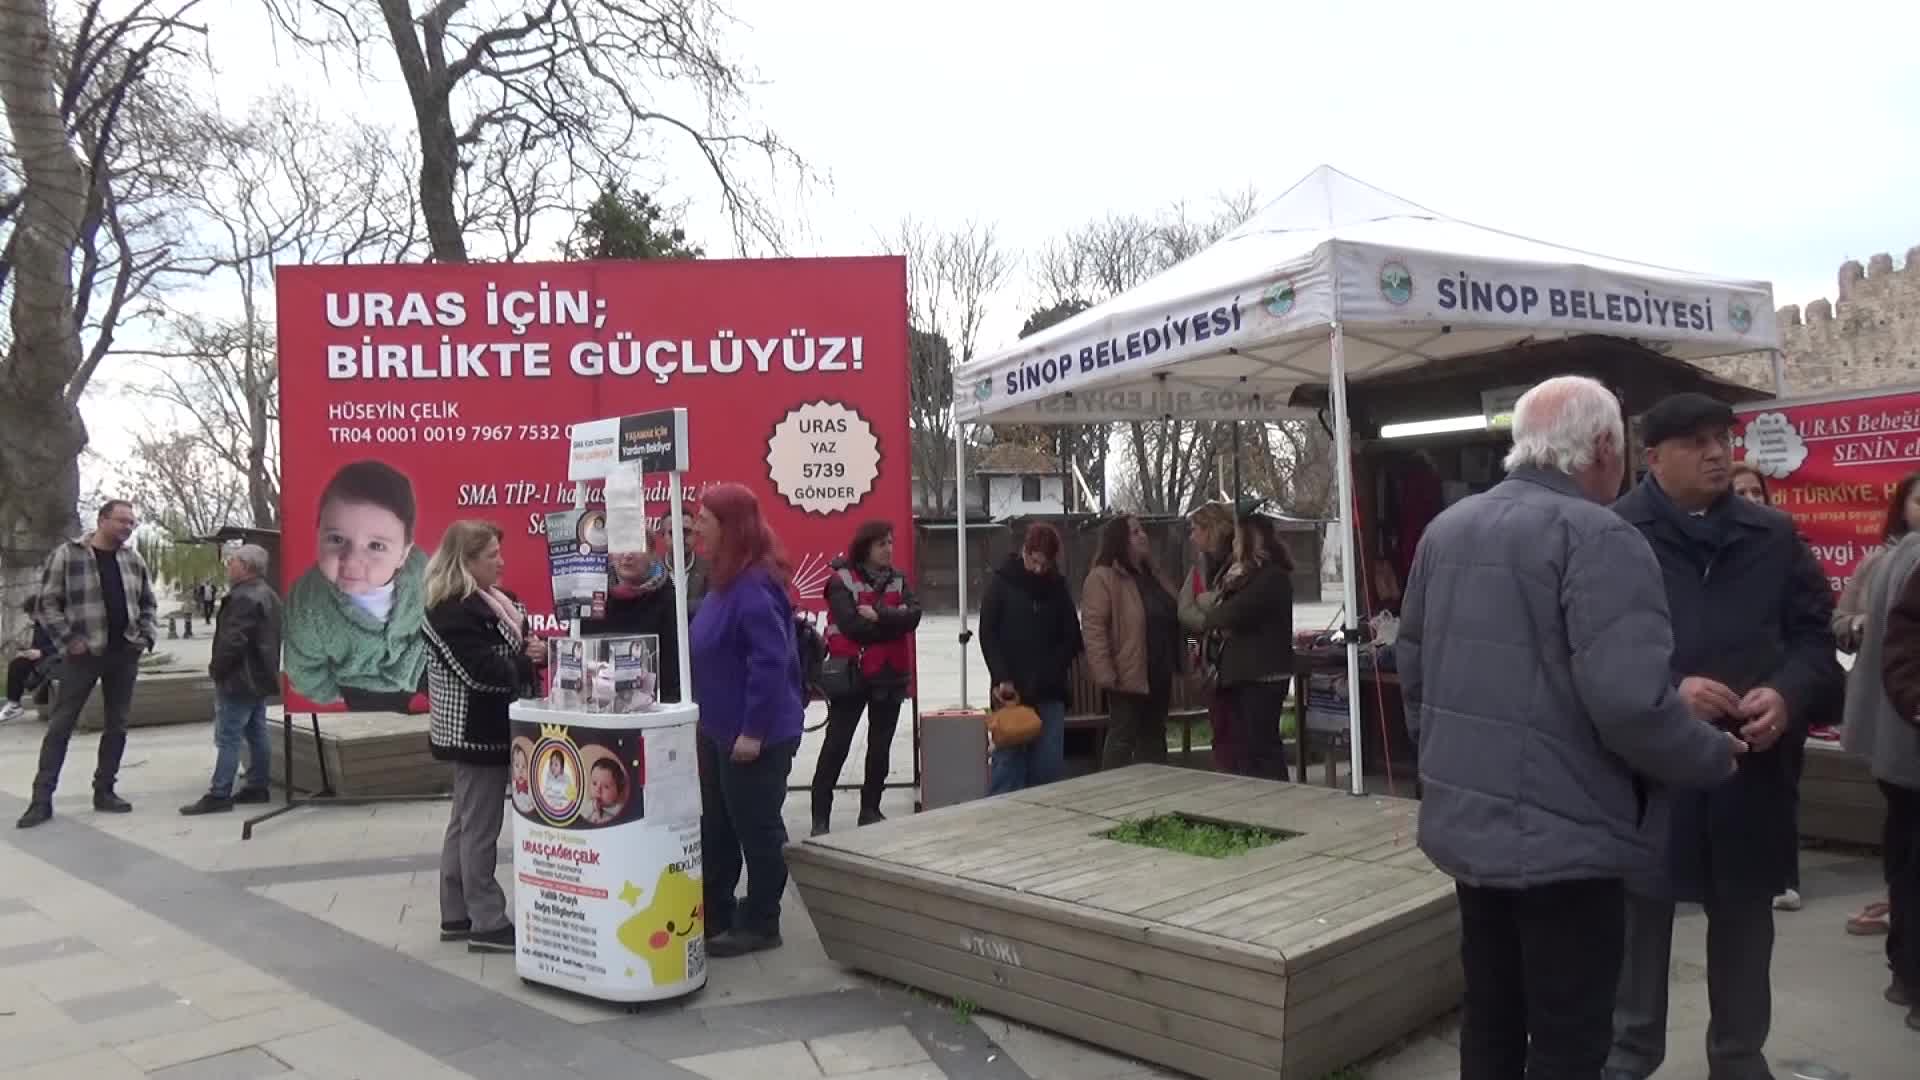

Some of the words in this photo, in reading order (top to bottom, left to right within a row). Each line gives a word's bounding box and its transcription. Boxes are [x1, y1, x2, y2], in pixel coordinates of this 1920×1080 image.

[326, 292, 467, 328] URAS
[487, 281, 607, 335] İÇİN;
[1438, 271, 1540, 316] SİNOP
[1550, 289, 1713, 332] BELEDİYESİ
[327, 335, 551, 379] BİRLİKTE
[569, 328, 864, 384] GÜÇLÜYÜZ!
[1006, 354, 1072, 396] SİNOP
[1080, 295, 1242, 374] BELEDİYESİ
[328, 400, 405, 420] HÜSEYİN
[410, 400, 459, 422] ÇELİK
[328, 427, 372, 443] TR04
[376, 426, 417, 442] 0001
[423, 426, 466, 442] 0019
[472, 425, 513, 441] 7967
[519, 425, 560, 440] 7532
[799, 418, 847, 433] URAS
[1800, 416, 1851, 437] URAS
[622, 444, 645, 457] Yardım
[646, 440, 671, 456] Bekliyor
[810, 441, 836, 454] YAZ
[1833, 436, 1898, 461] SENİN
[803, 462, 845, 478] 5739
[457, 483, 498, 505] SMA
[504, 480, 550, 505] TİP-1
[794, 484, 855, 499] GÖNDER
[1772, 488, 1787, 505] di
[1811, 540, 1853, 566] evgi
[528, 614, 569, 631] RAS
[522, 839, 543, 856] URAS
[573, 848, 600, 866] ÇELİK
